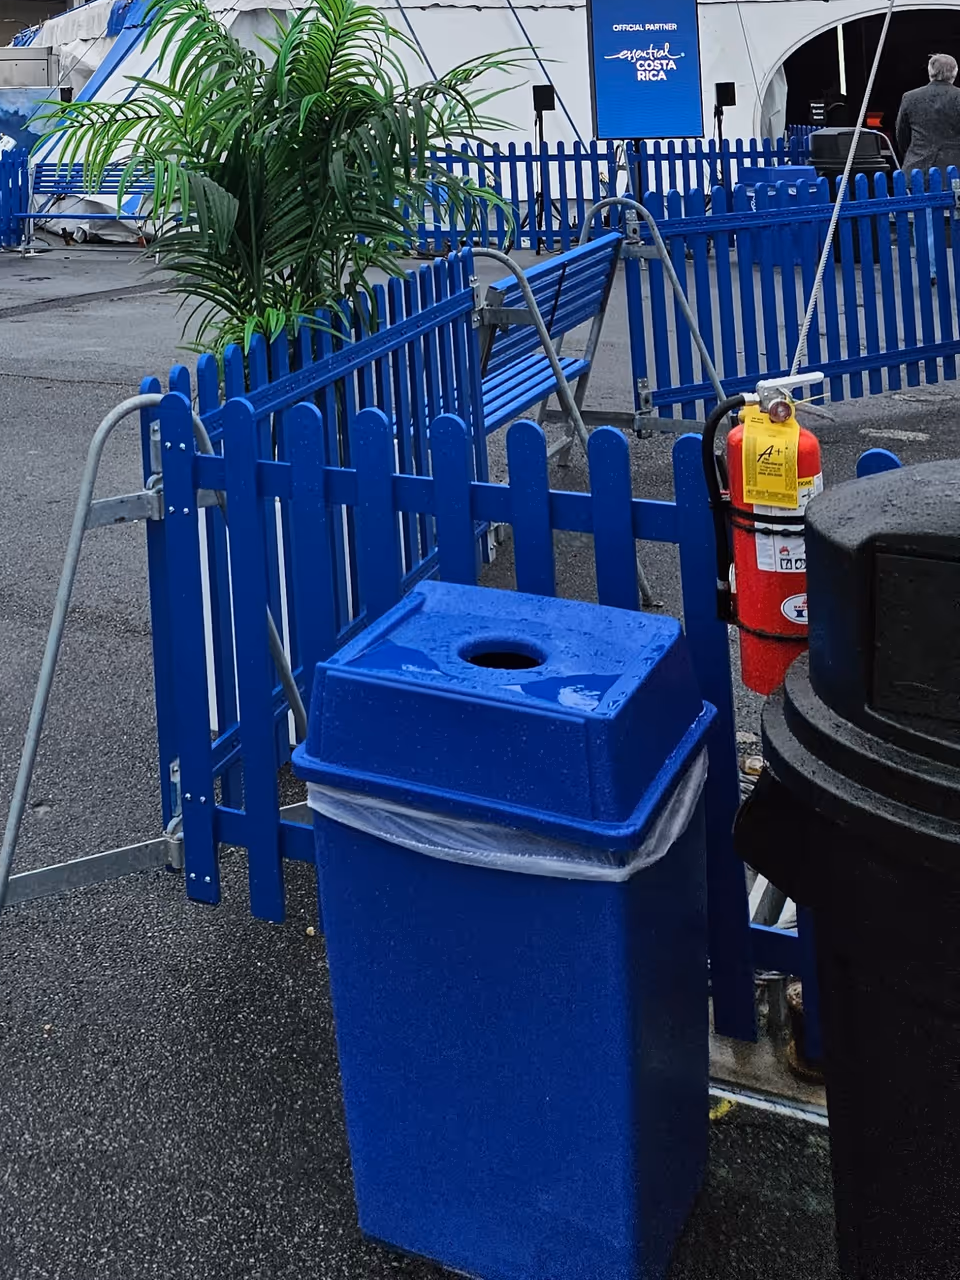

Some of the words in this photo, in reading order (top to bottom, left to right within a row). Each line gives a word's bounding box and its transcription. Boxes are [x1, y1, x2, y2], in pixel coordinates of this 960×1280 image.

[612, 24, 644, 32] OFFICIAL
[645, 23, 678, 31] PARTNER
[604, 42, 683, 62] essential
[636, 60, 677, 71] COSTA
[637, 71, 668, 81] RICA
